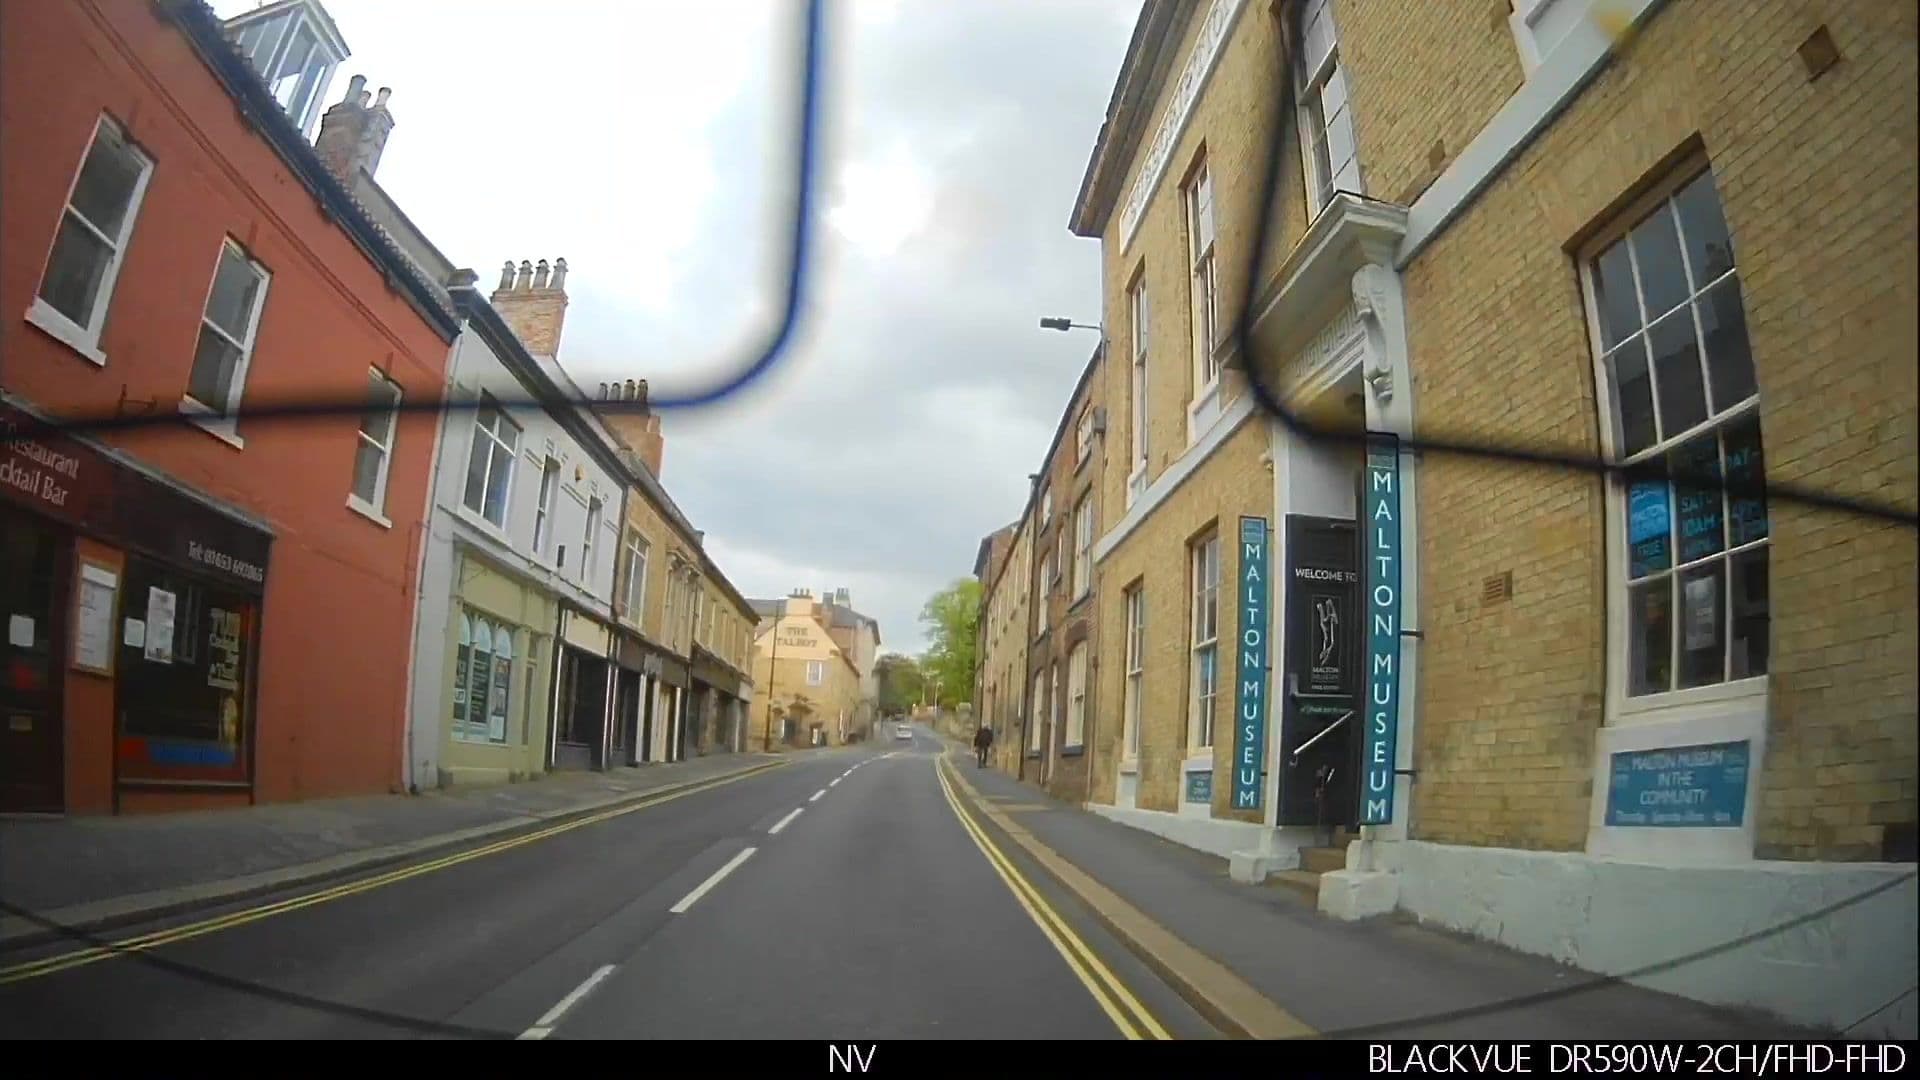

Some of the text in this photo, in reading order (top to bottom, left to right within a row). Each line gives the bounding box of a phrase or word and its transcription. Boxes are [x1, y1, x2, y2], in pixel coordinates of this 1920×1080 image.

[42, 475, 69, 506] Bar
[1295, 567, 1342, 581] WELCOME
[787, 626, 808, 637] THE
[777, 637, 818, 648] TALBOT
[1367, 470, 1394, 821] MALTON MUSEUM
[1239, 543, 1261, 807] MALTON MUSEUM
[1658, 770, 1694, 786] IN THE
[1640, 788, 1709, 806] COMMUNITY
